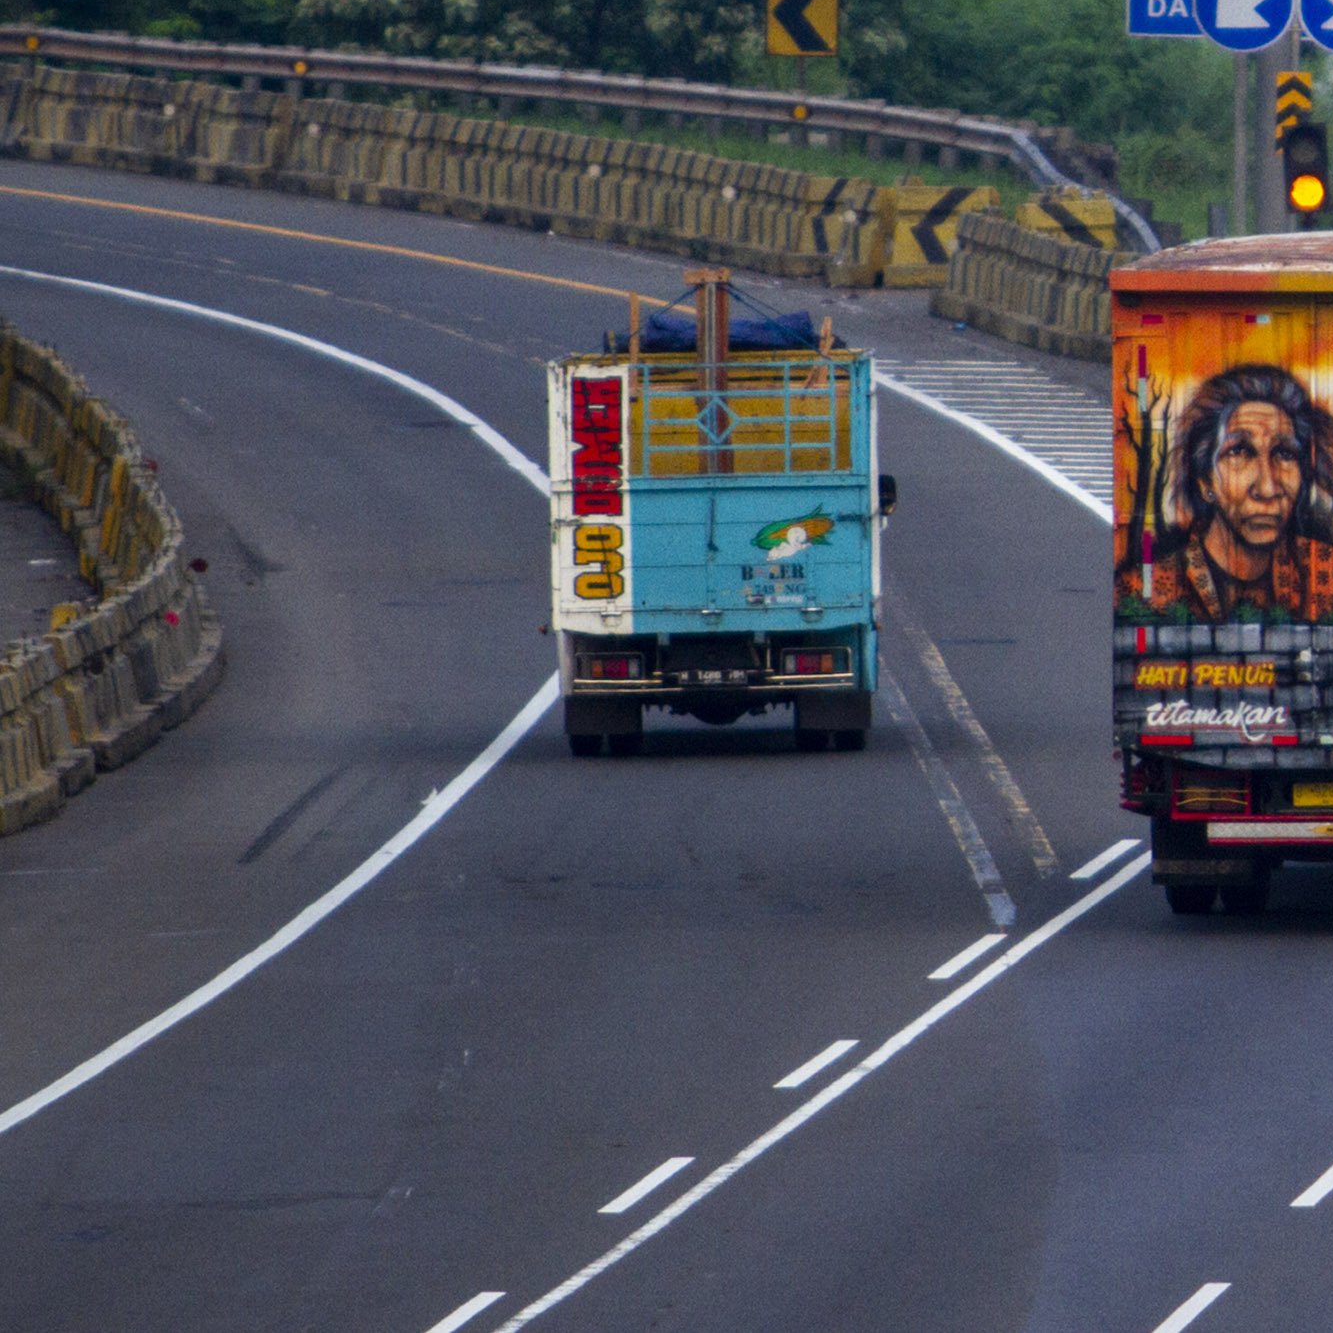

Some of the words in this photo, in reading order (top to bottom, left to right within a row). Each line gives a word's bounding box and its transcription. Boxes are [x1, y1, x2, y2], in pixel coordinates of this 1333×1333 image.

[573, 523, 625, 600] OJO
[1137, 665, 1188, 686] HATI
[1194, 662, 1276, 686] PENUH
